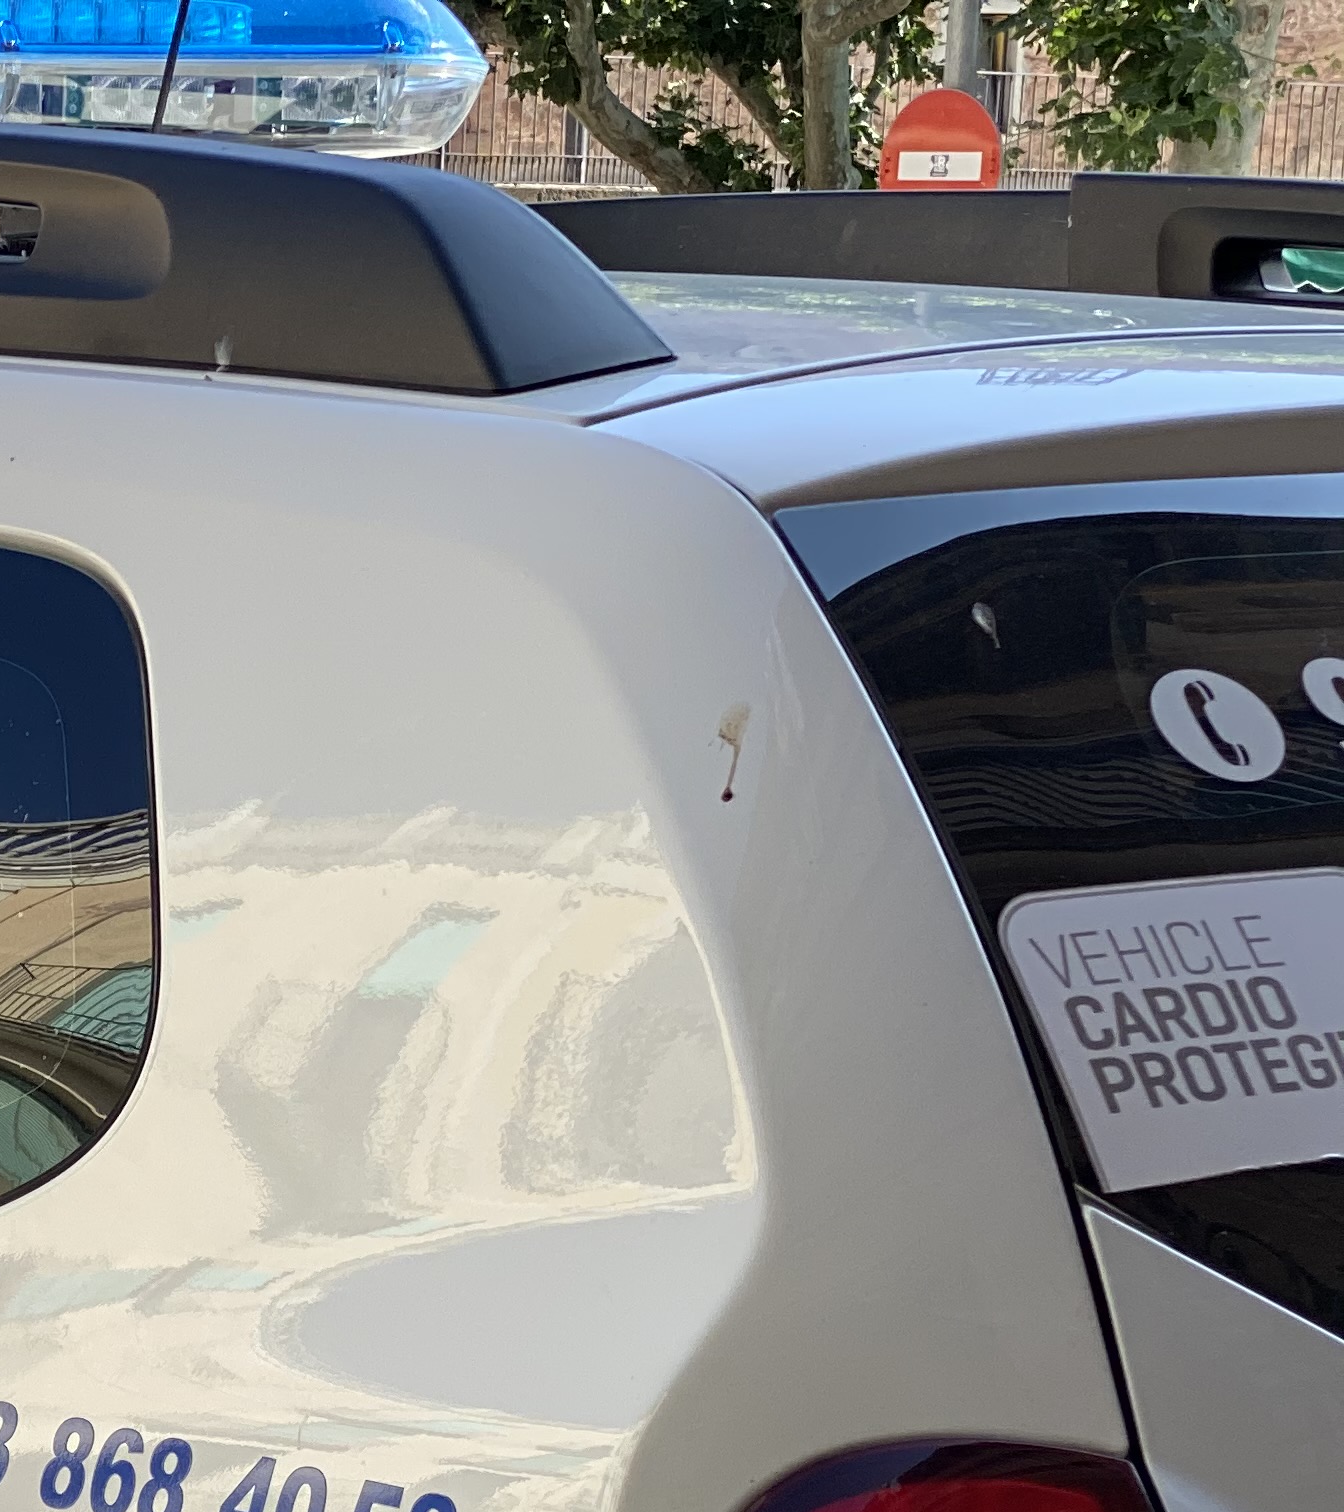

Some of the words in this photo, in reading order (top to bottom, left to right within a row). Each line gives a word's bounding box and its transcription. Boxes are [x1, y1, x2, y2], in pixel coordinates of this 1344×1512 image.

[1028, 914, 1286, 989] VEHICLE
[1064, 976, 1299, 1051] CARDIO
[1088, 1031, 1344, 1114] PROTEGI
